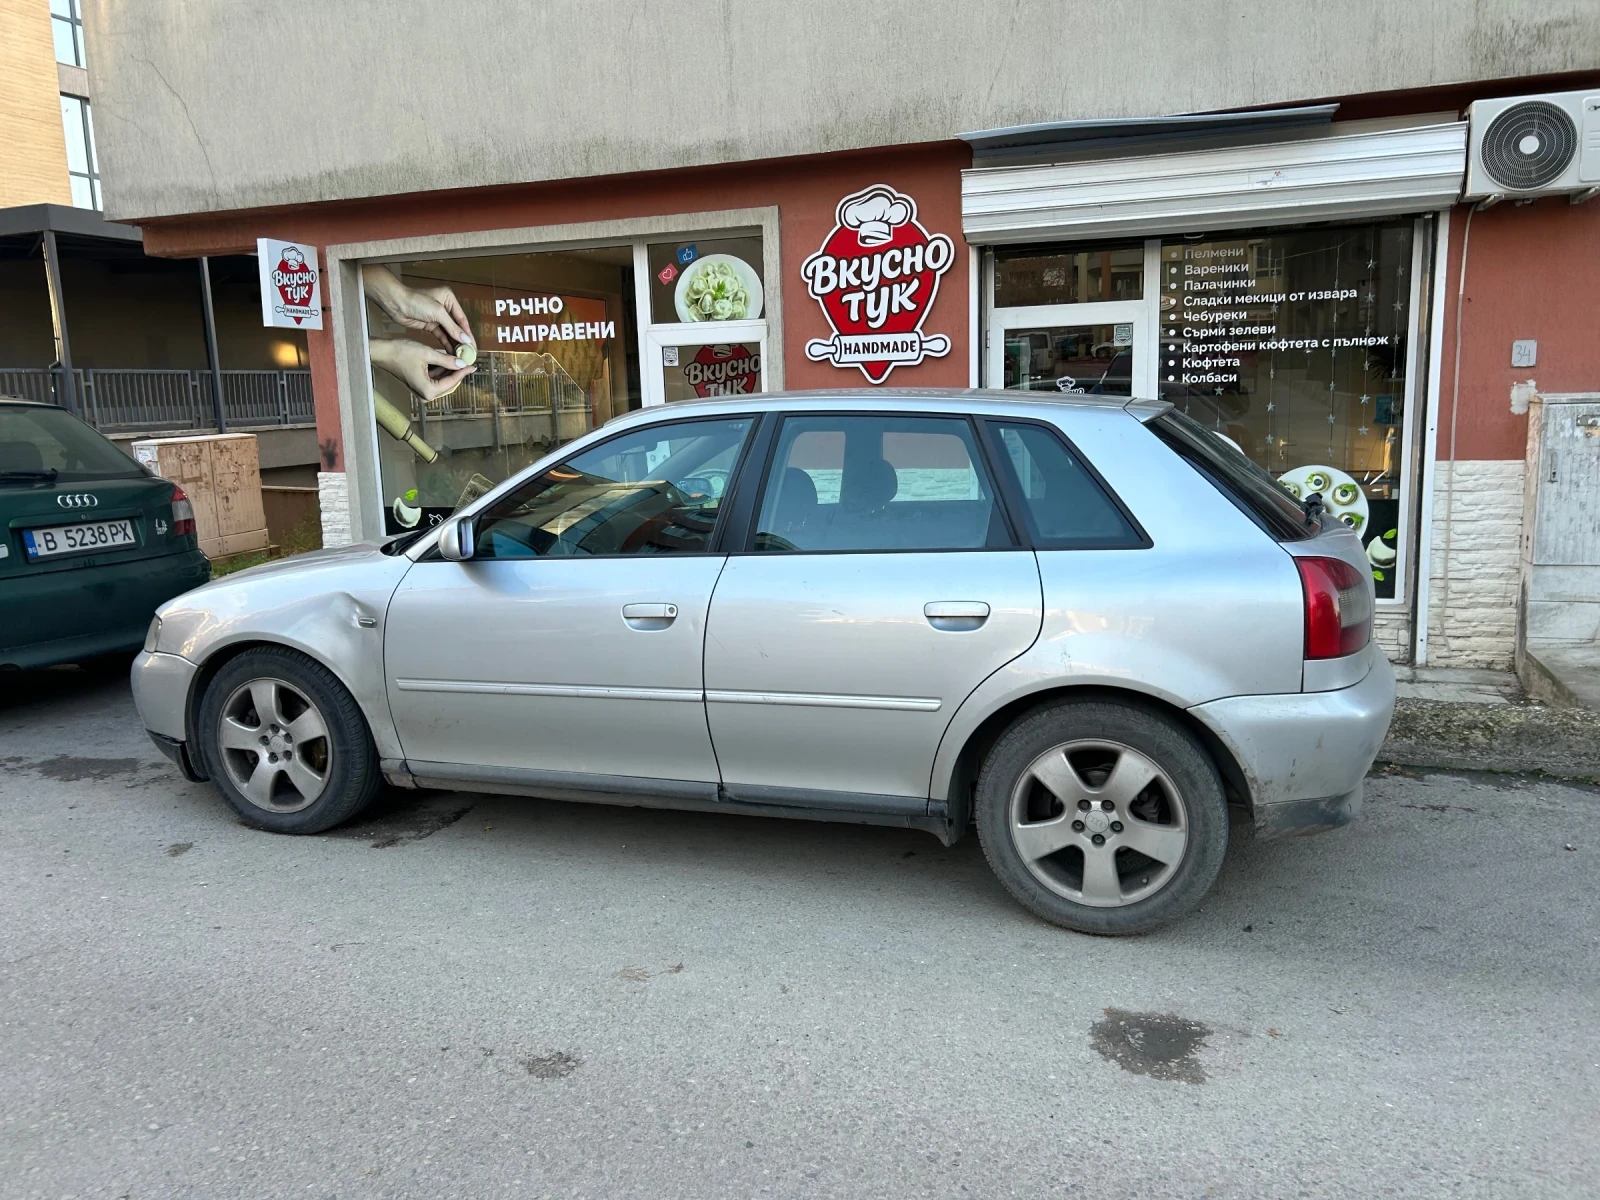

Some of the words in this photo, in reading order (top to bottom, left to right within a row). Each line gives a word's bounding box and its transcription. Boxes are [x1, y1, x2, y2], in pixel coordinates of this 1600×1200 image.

[1184, 247, 1244, 260] Пелмени
[1184, 263, 1249, 276] Вареники
[1184, 278, 1256, 291] Палачинки
[1183, 295, 1232, 307] Сладки
[1235, 293, 1286, 305] мекици
[1289, 291, 1305, 301] от
[1308, 288, 1358, 301] извара
[495, 296, 563, 316] РЪЧНО
[1183, 310, 1247, 323] Чебуреки
[497, 321, 615, 343] НАПРАВЕНИ
[1182, 326, 1226, 340] Сърми
[1229, 325, 1276, 336] зелеви
[843, 339, 917, 355] HANDMADE
[1182, 341, 1256, 354] Картофени
[1259, 337, 1319, 352] кюфтета
[1321, 338, 1330, 347] с
[1333, 335, 1389, 347] пълнеж
[1513, 344, 1531, 364] 34
[1181, 356, 1241, 370] Кюфтета
[1181, 373, 1238, 384] Колбаси
[64, 524, 108, 548] 5238
